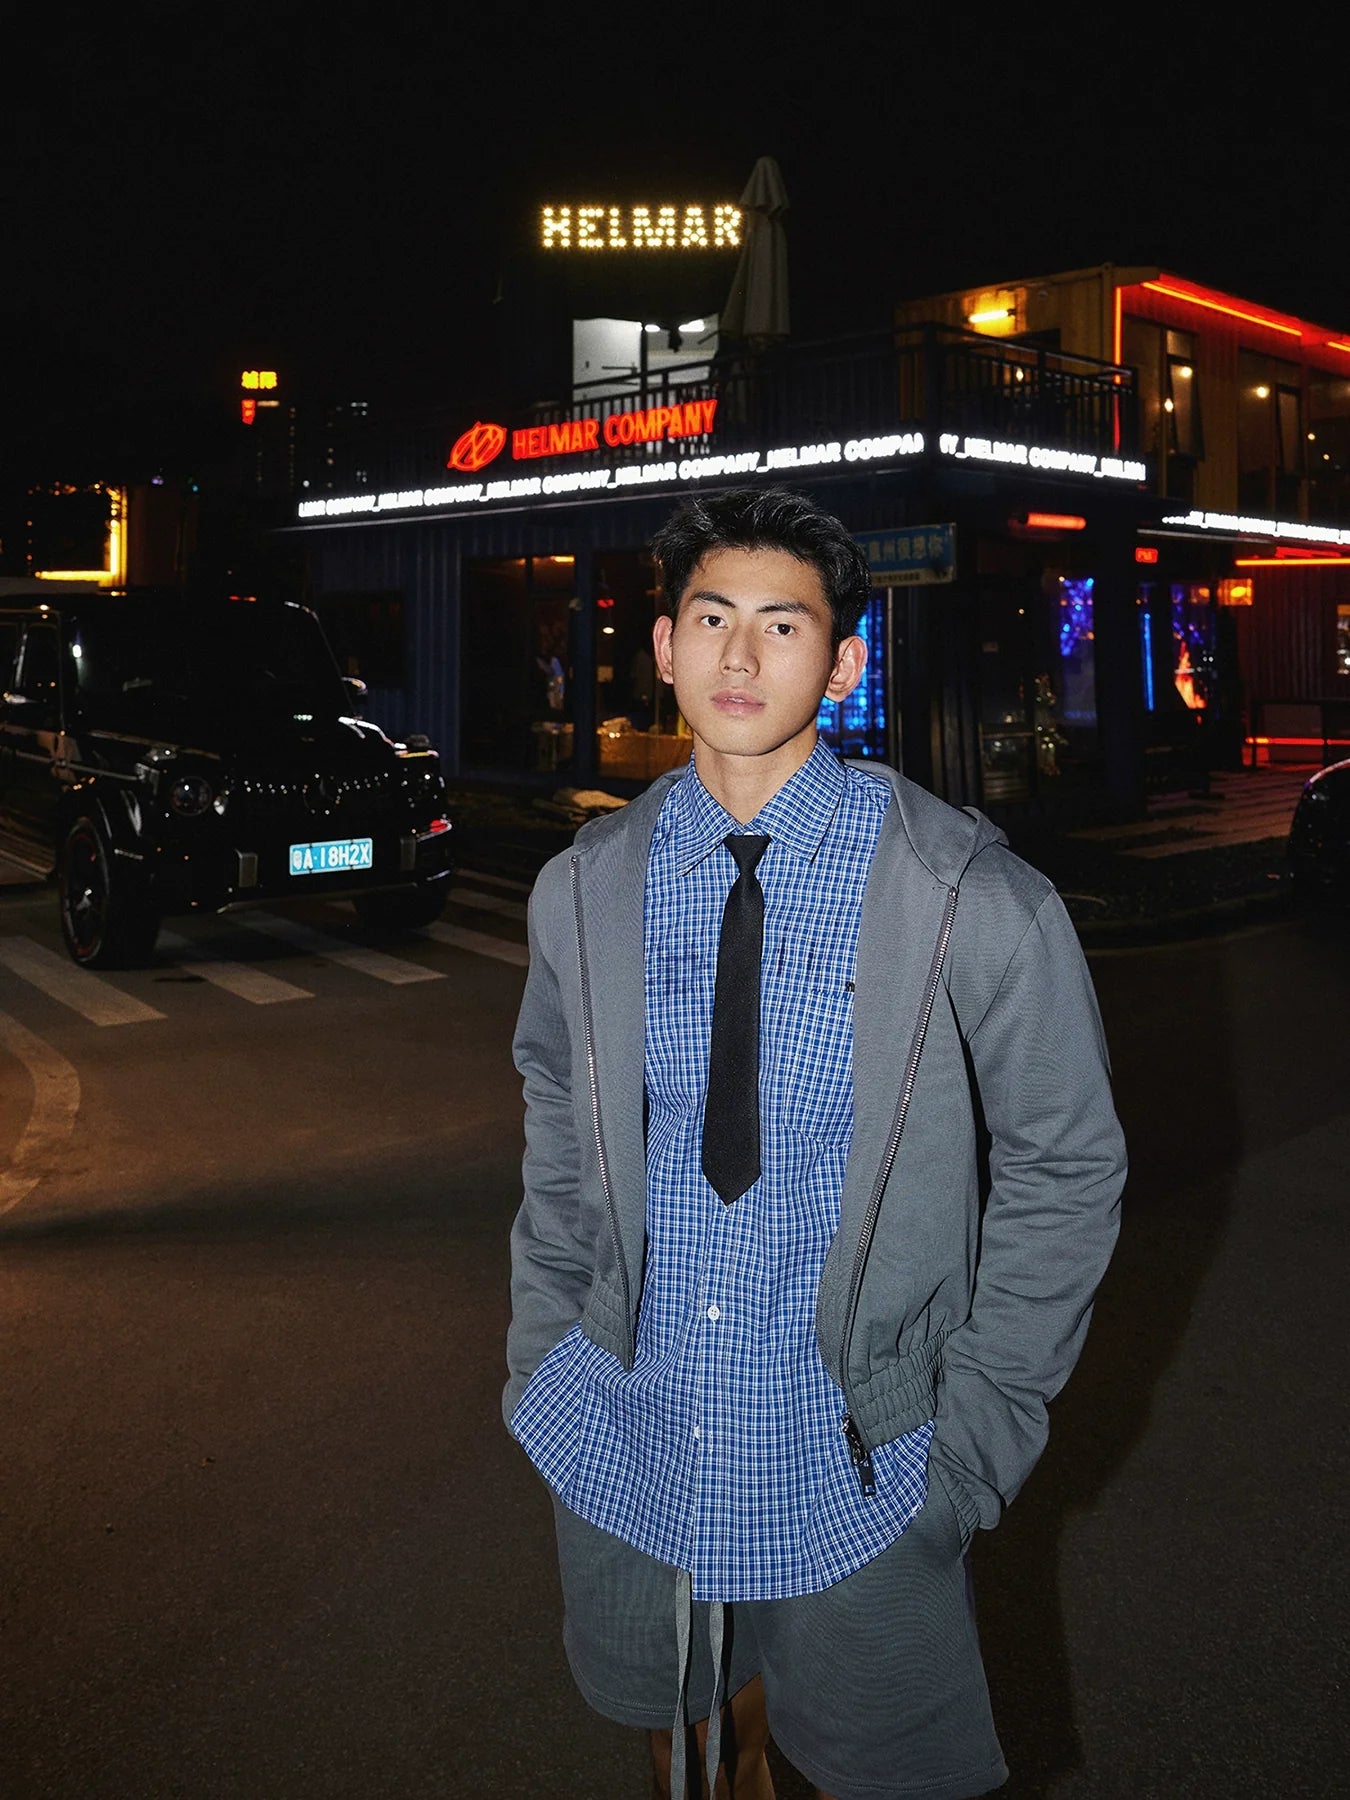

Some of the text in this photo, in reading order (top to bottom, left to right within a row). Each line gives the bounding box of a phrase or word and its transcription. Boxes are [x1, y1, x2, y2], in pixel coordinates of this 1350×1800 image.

[541, 204, 743, 249] HELMAR
[512, 399, 718, 460] HELMAR COMPANY
